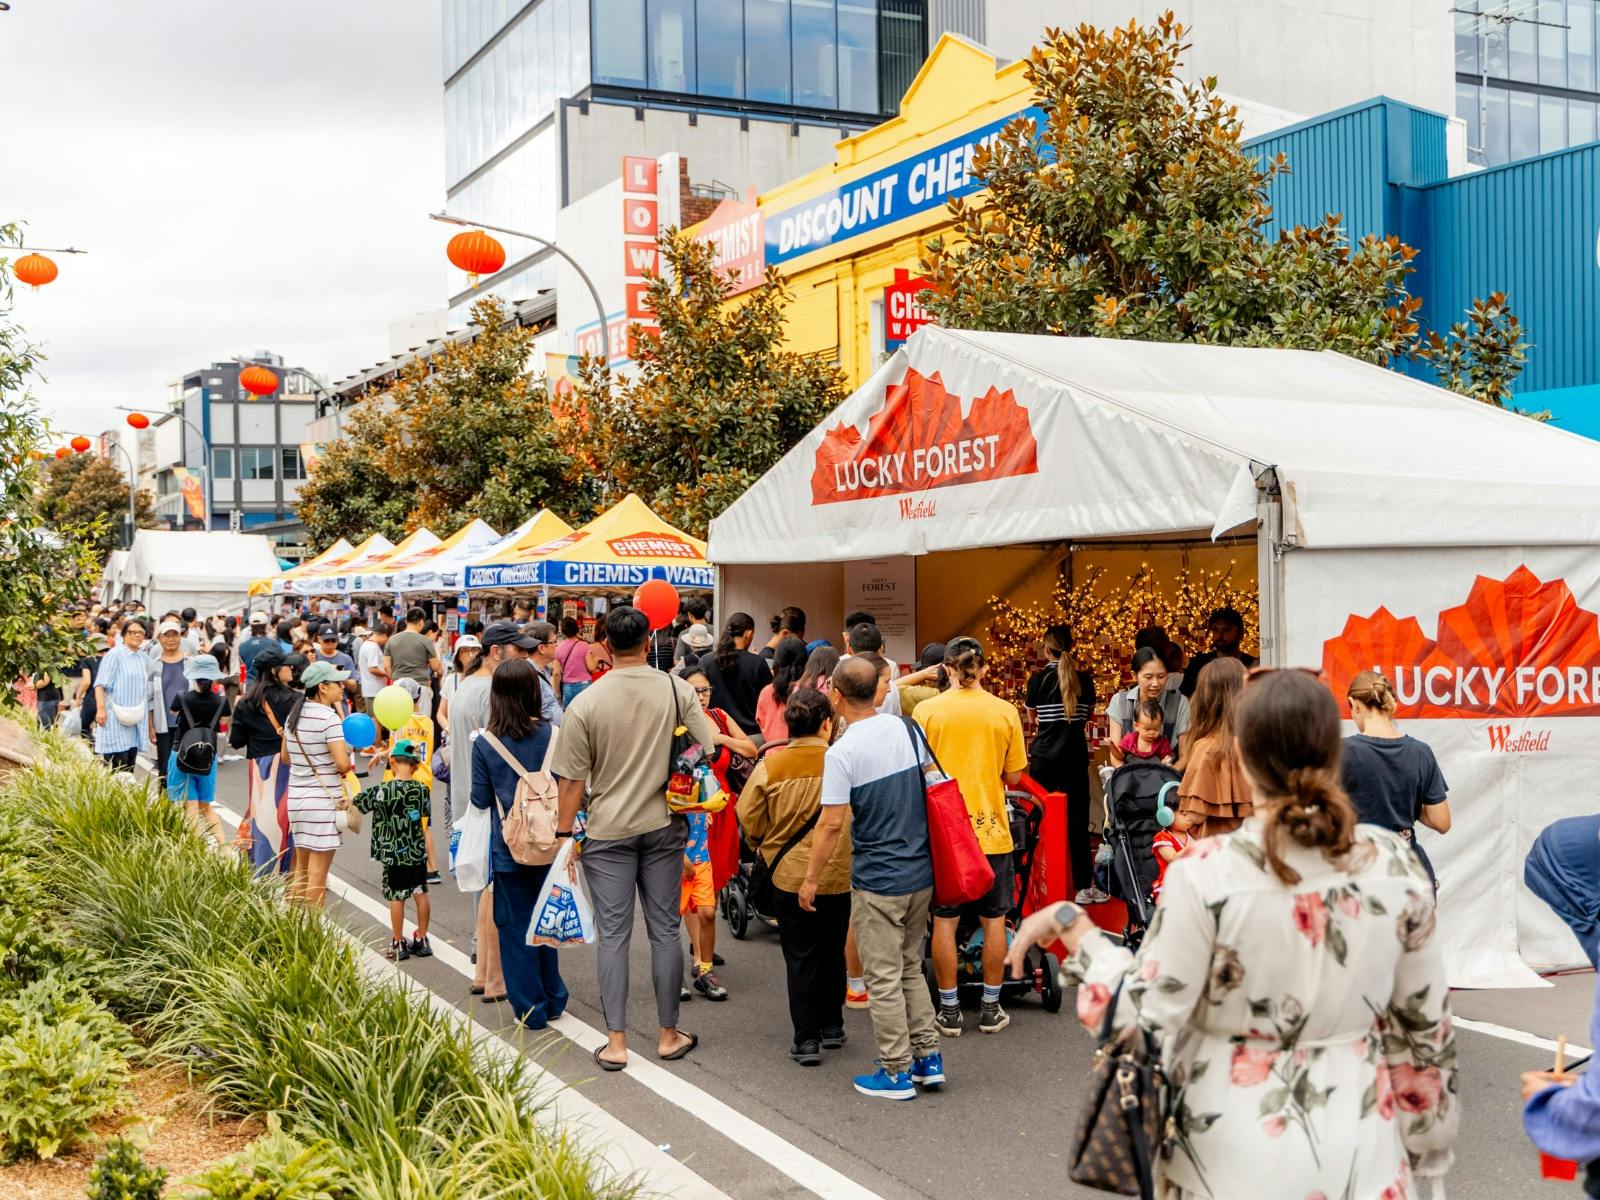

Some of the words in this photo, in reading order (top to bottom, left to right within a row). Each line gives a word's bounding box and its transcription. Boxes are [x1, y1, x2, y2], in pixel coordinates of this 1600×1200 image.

[779, 173, 898, 255] DISCOUNT
[631, 164, 656, 312] LOWE
[834, 454, 906, 492] LUCKY
[913, 435, 999, 481] FOREST
[899, 498, 936, 520] Westfield
[611, 540, 693, 552] CHEMIST
[470, 568, 501, 586] CHEMIST
[565, 563, 656, 584] CHEMIST
[862, 583, 896, 591] FOREST
[1373, 665, 1506, 705] UCKY
[1487, 724, 1552, 753] Westfield
[564, 919, 580, 930] OFF
